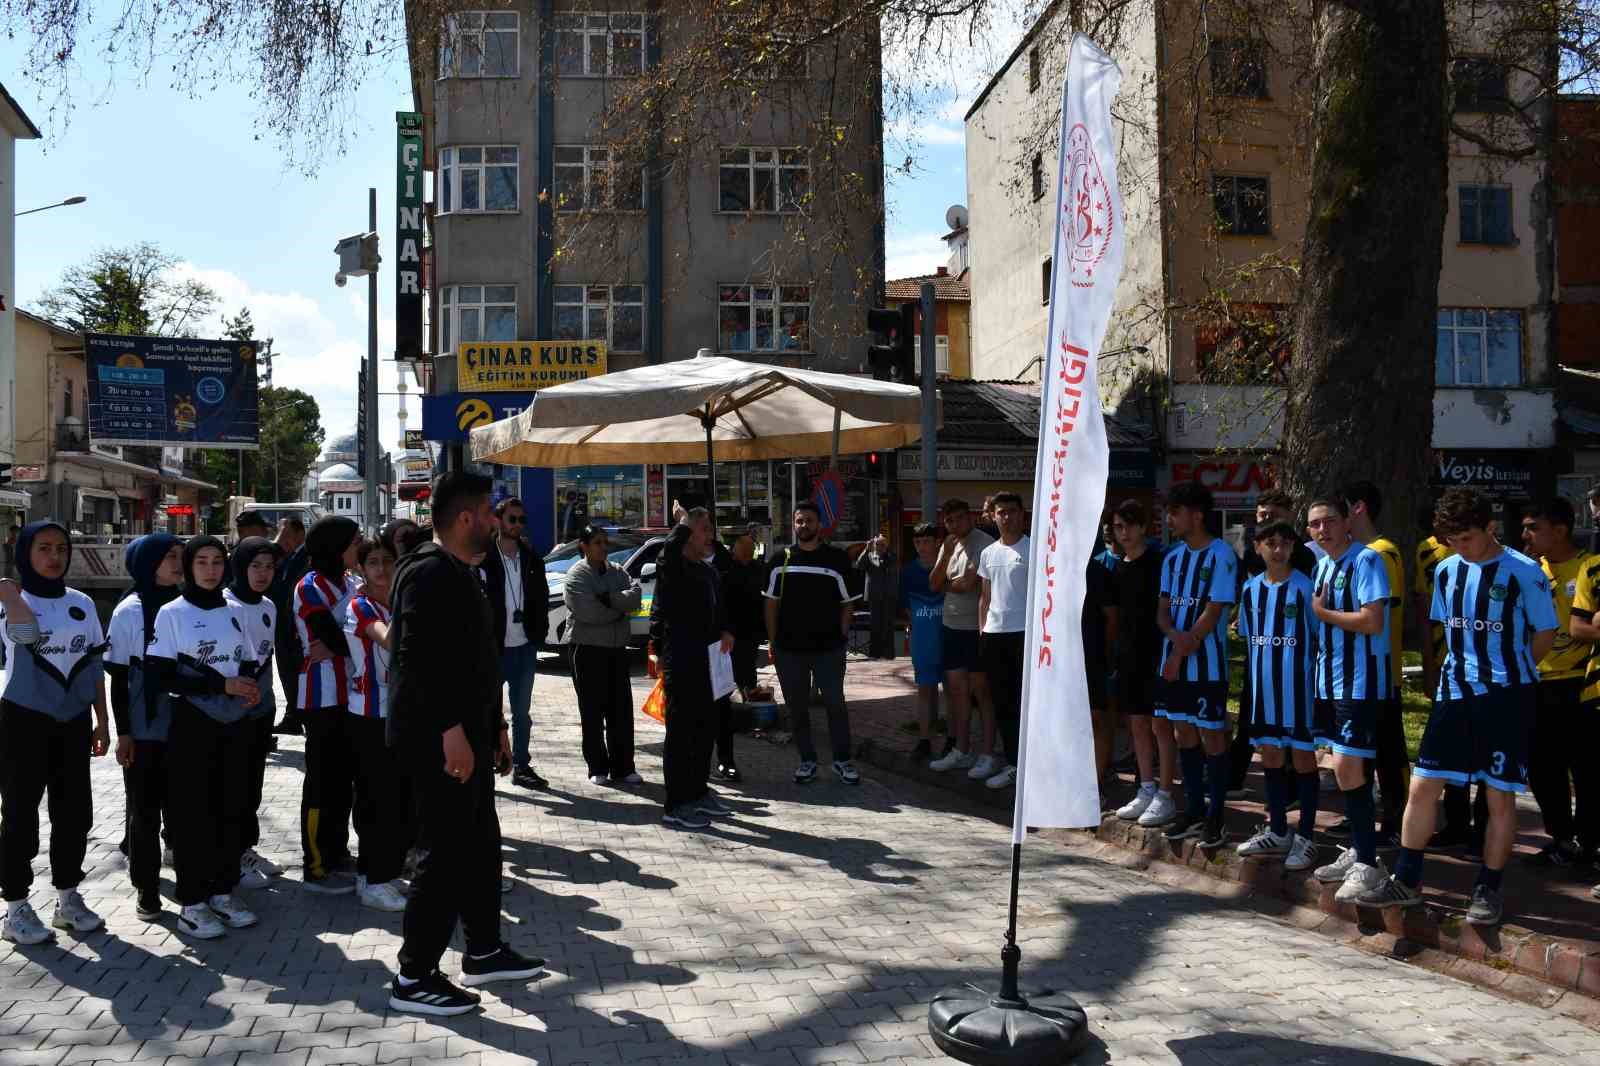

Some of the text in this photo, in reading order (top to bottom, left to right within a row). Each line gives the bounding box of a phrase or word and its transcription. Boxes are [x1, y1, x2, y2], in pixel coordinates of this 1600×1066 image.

[400, 143, 420, 294] ÇINAR
[466, 346, 598, 370] ÇINAR KURS
[478, 368, 588, 382] EĞİTİM KURUMU
[1440, 457, 1495, 484] Veyis
[1473, 619, 1504, 633] OTO
[1272, 636, 1298, 648] OTO
[1197, 697, 1208, 719] 2
[1340, 719, 1353, 745] 4
[1491, 751, 1506, 776] 3
